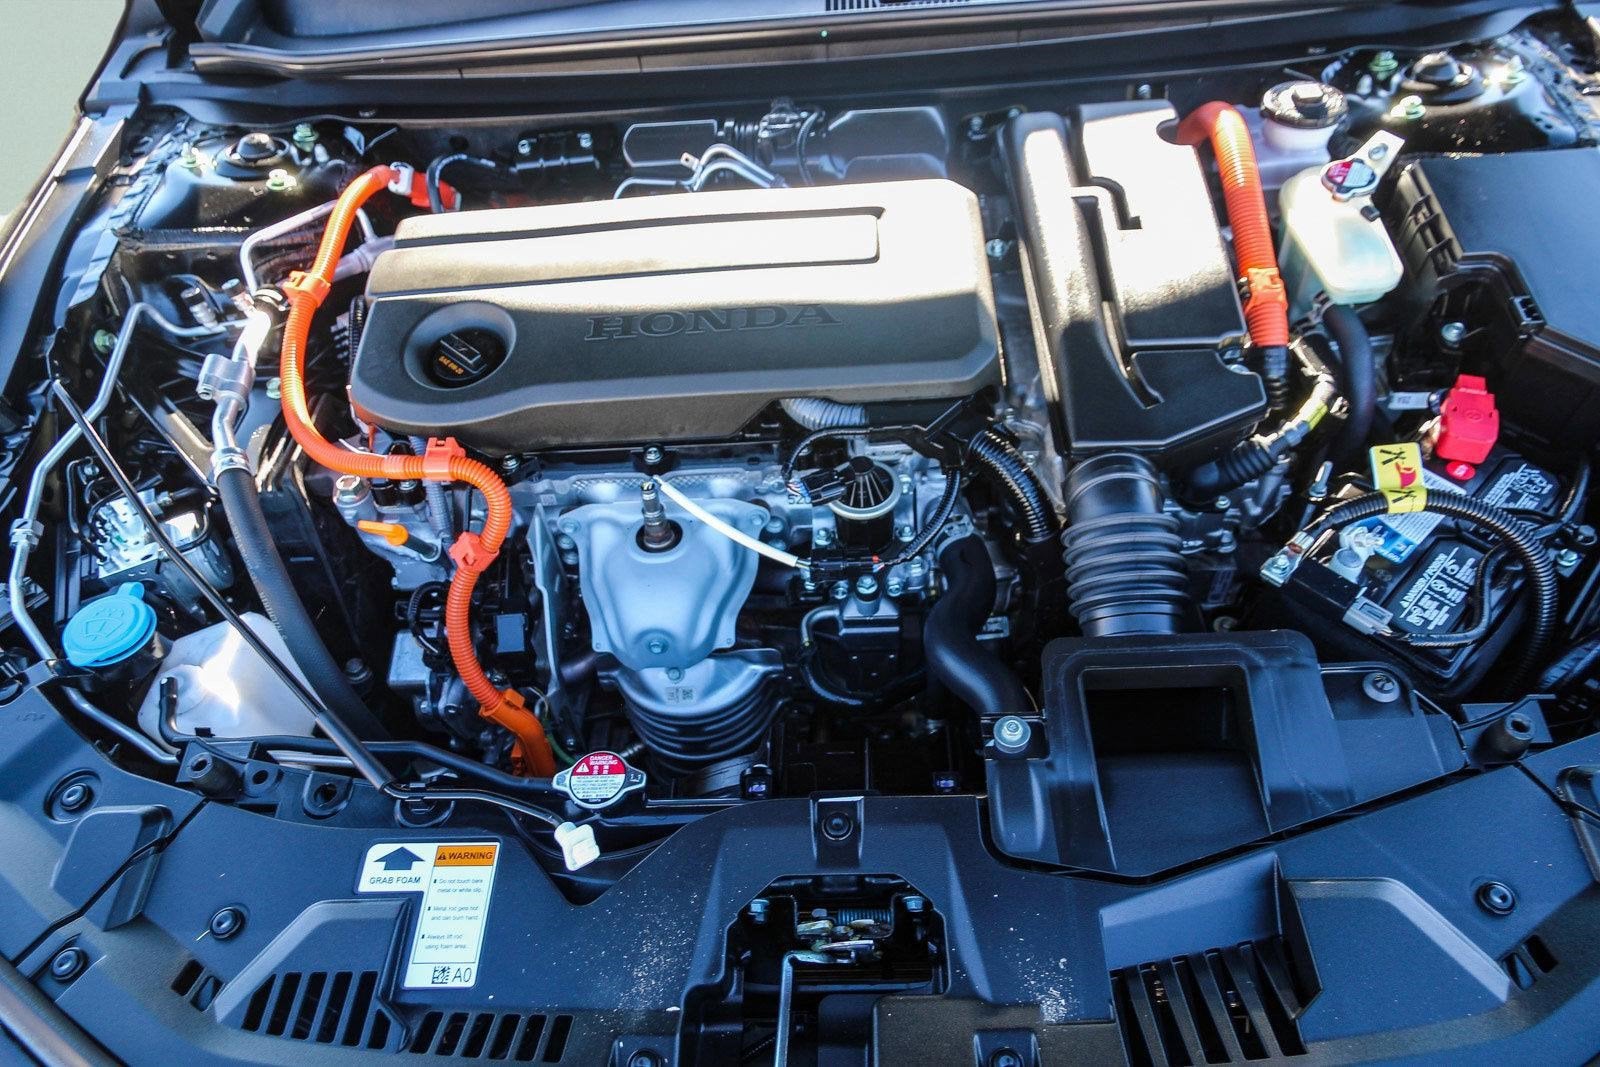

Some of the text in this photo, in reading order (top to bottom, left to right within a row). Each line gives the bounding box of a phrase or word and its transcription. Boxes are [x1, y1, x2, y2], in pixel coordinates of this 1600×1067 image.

[584, 303, 844, 342] HONDA
[448, 851, 493, 860] WARNING
[369, 876, 421, 885] GRAB FOAM
